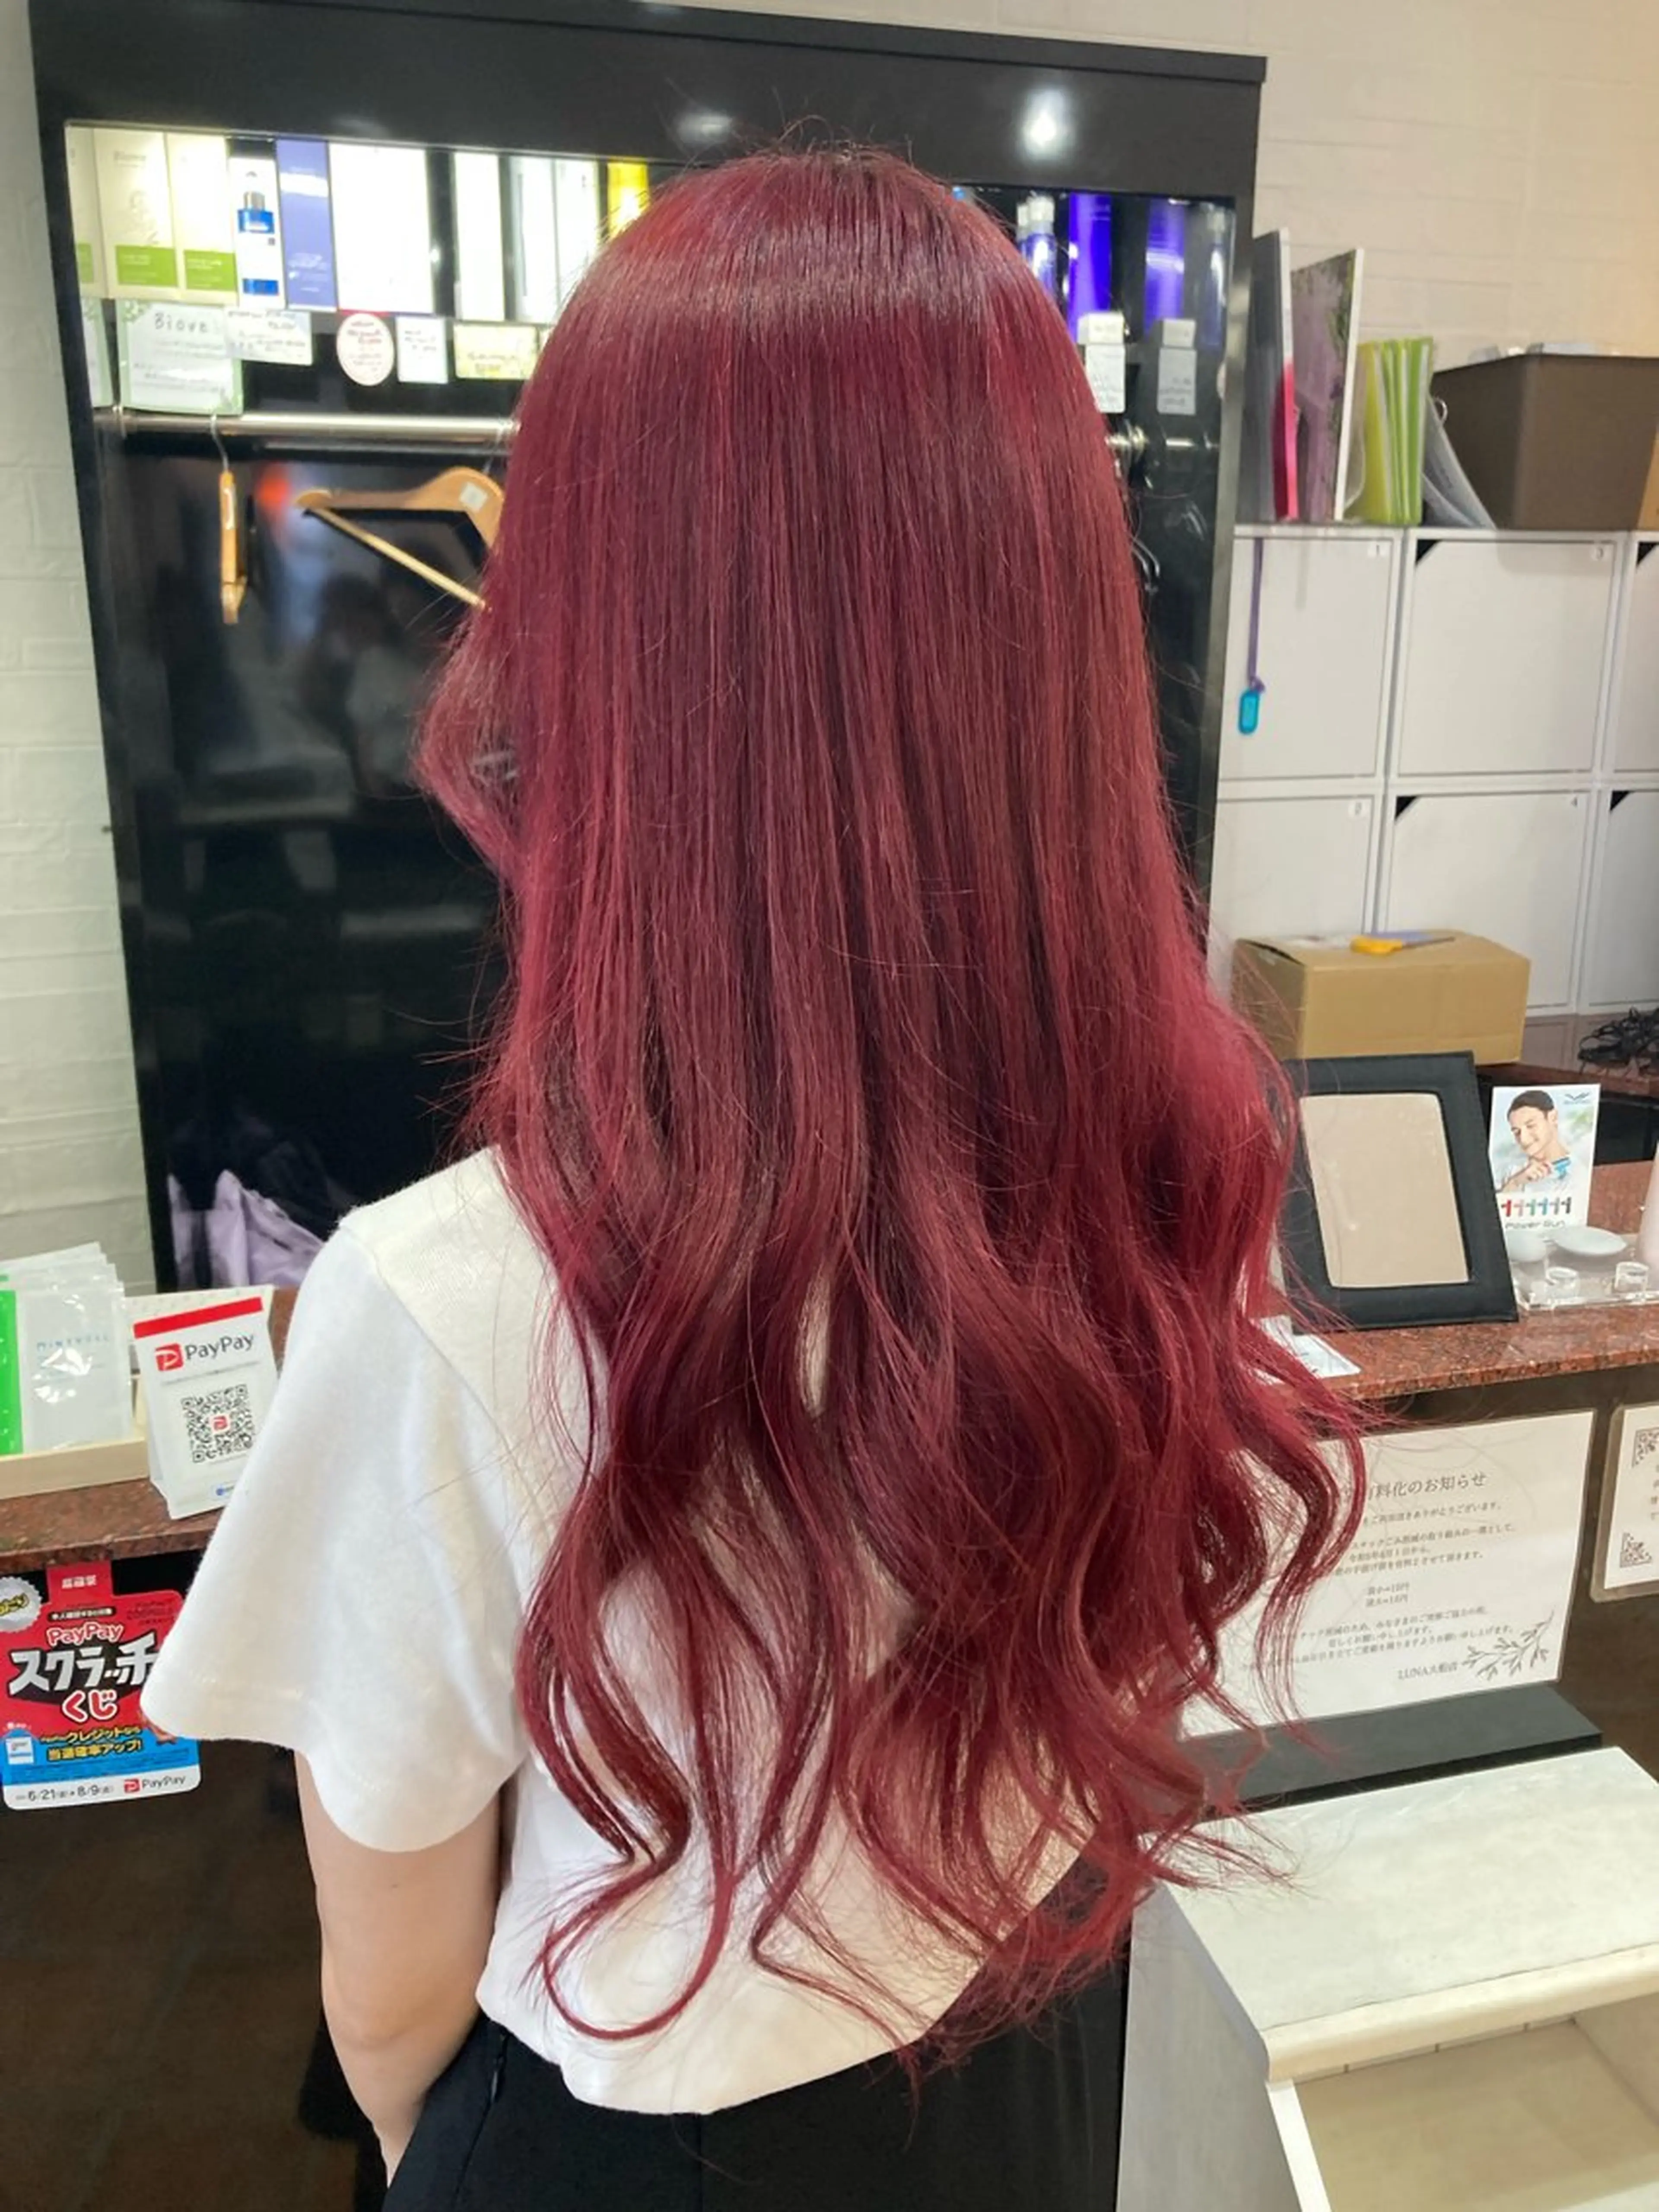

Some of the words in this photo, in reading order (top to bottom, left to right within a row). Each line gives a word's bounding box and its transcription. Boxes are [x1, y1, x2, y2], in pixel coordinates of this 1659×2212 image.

[185, 1334, 254, 1360] PayPay
[46, 1621, 124, 1646] PayPay
[9, 1631, 159, 1696] スクラッチ
[62, 1689, 118, 1722] くじ
[142, 1776, 185, 1789] PayPay
